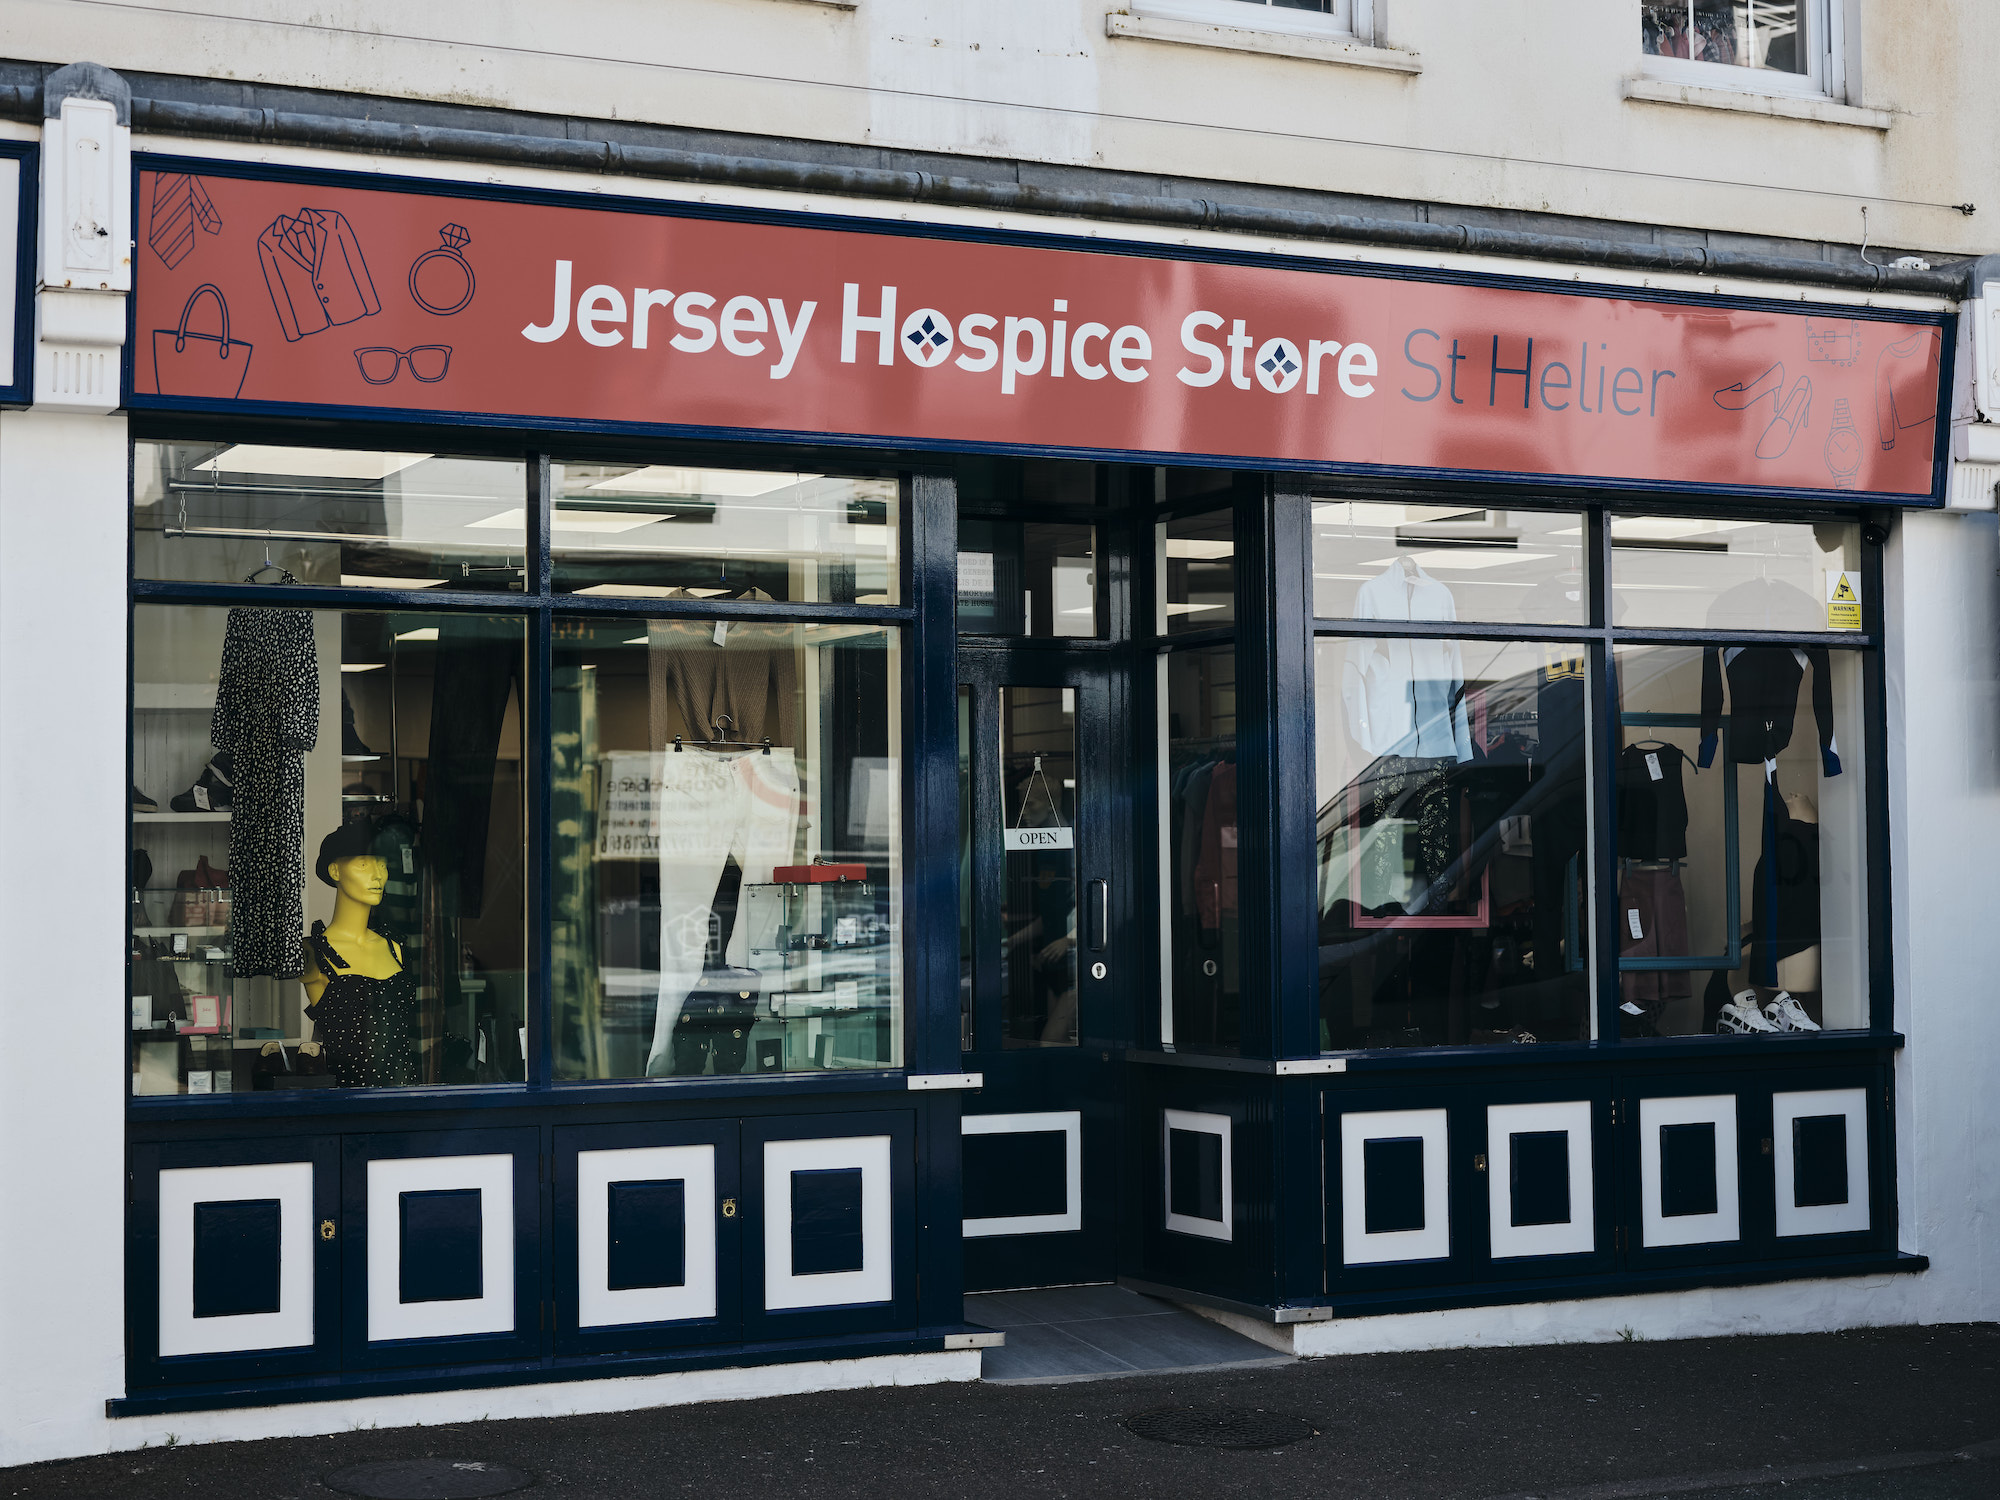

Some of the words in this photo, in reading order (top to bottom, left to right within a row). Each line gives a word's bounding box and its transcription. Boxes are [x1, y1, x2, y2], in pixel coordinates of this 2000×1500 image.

[521, 260, 818, 380] Jersey
[840, 282, 1153, 395] Hospice
[1176, 310, 1378, 398] Store
[1400, 328, 1466, 404] St
[1489, 334, 1677, 417] Helier
[1019, 832, 1057, 844] OPEN
